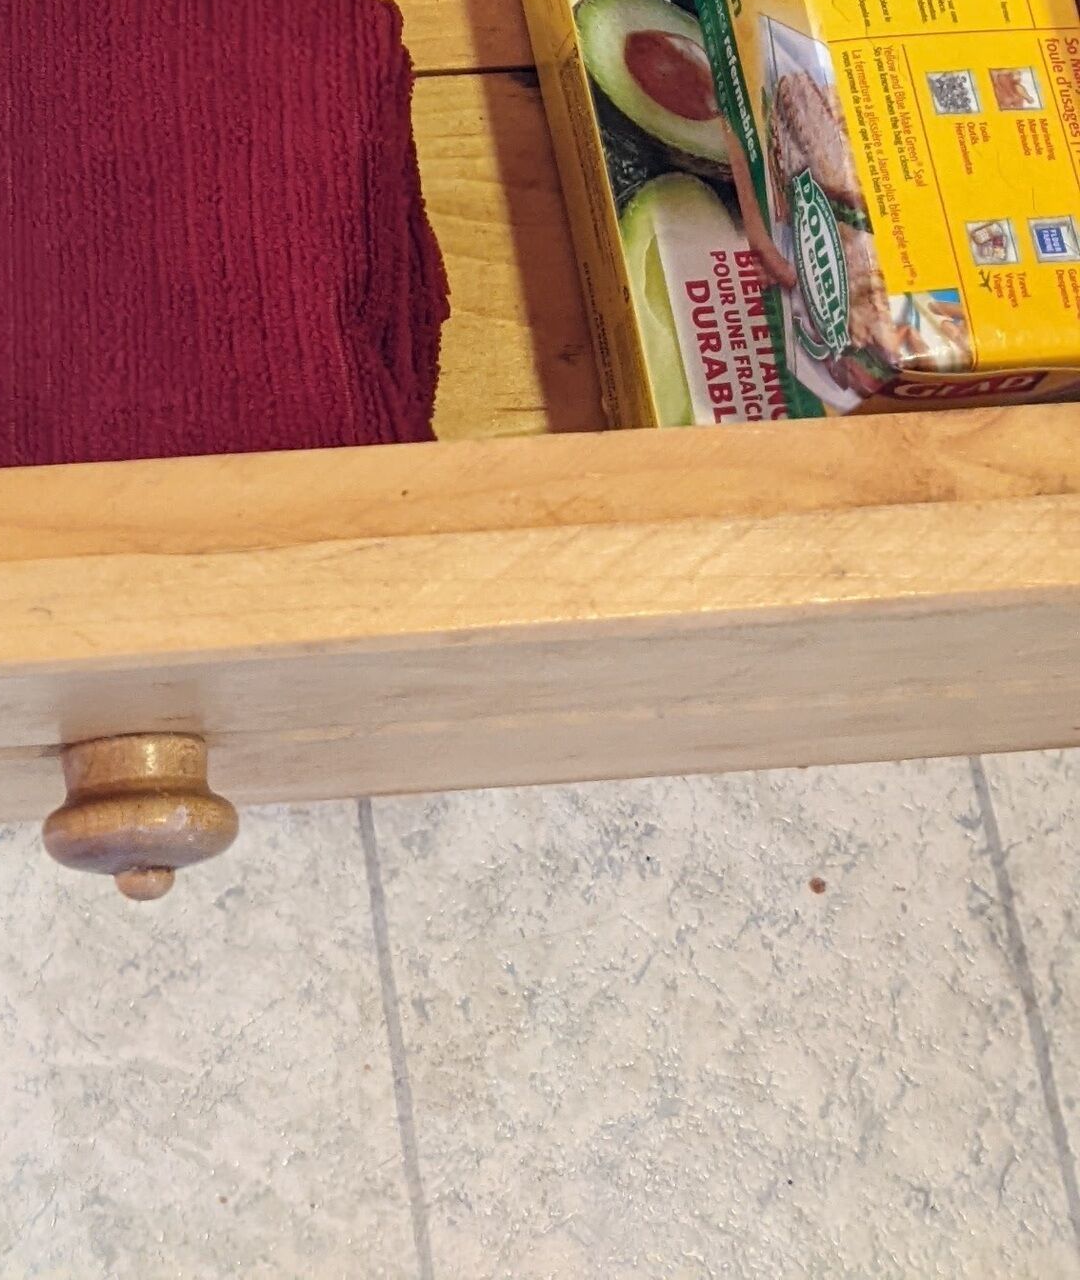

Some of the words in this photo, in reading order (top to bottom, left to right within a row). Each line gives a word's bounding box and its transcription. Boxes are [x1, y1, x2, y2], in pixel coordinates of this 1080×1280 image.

[851, 49, 861, 59] La
[873, 47, 881, 57] So
[1064, 38, 1079, 54] So
[842, 51, 851, 67] vous
[874, 58, 884, 72] you
[881, 45, 896, 72] Yellow
[845, 69, 858, 93] permet
[855, 61, 871, 102] fermeture
[880, 73, 889, 93] know
[890, 74, 903, 90] and
[1046, 38, 1066, 72] foule
[1057, 77, 1080, 137] d'usages
[724, 37, 756, 161] refermables
[852, 95, 860, 104] de
[885, 95, 895, 115] when
[894, 91, 906, 109] Blue
[864, 112, 882, 147] glissière
[890, 116, 899, 129] the
[900, 112, 912, 134] Make
[979, 122, 990, 142] Tools
[859, 128, 869, 141] que
[894, 131, 903, 145] bag
[967, 122, 978, 144] Outils
[865, 151, 874, 163] sac
[878, 158, 890, 181] Jaune
[914, 169, 927, 187] Seal
[872, 177, 881, 193] bien
[882, 184, 895, 202] plus
[889, 204, 901, 223] bleu
[892, 225, 908, 249] égale
[800, 173, 848, 346] DOUBLE
[711, 251, 736, 304] POUR
[724, 310, 746, 350] UNE
[894, 375, 1035, 398] GLAD
